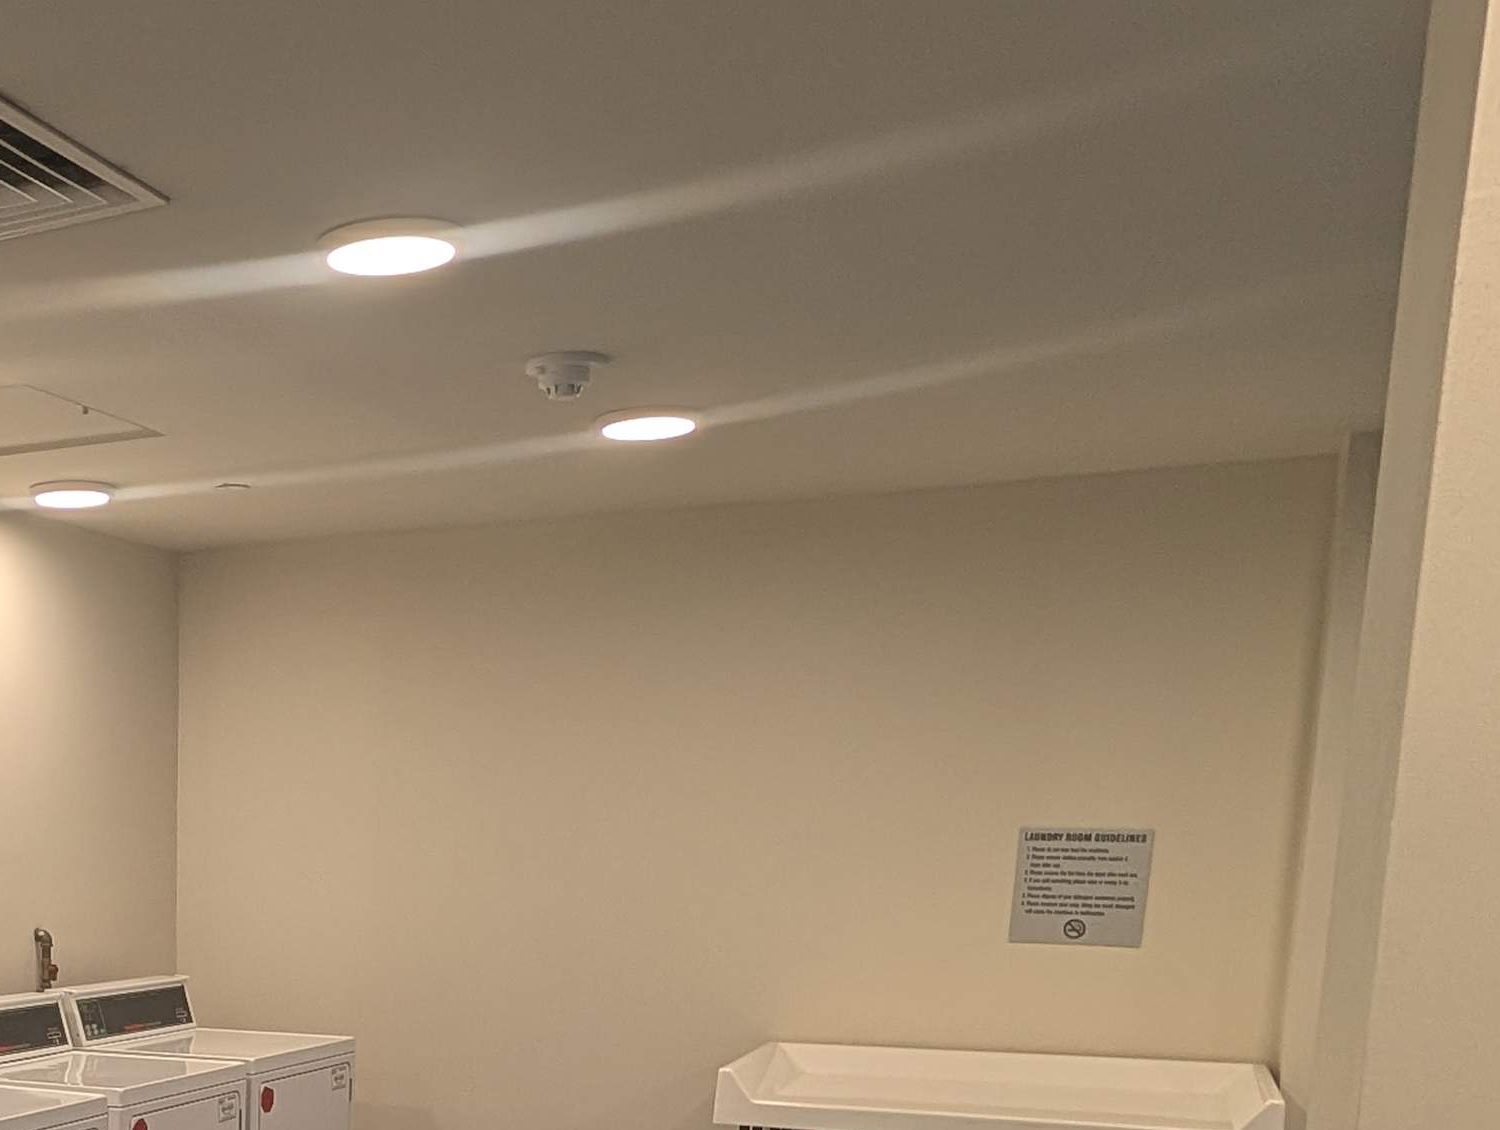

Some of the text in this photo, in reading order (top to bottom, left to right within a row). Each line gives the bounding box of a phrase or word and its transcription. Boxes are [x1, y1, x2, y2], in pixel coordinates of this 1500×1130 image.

[1024, 831, 1147, 843] LAUNDRY ROOM GUIDELINES
